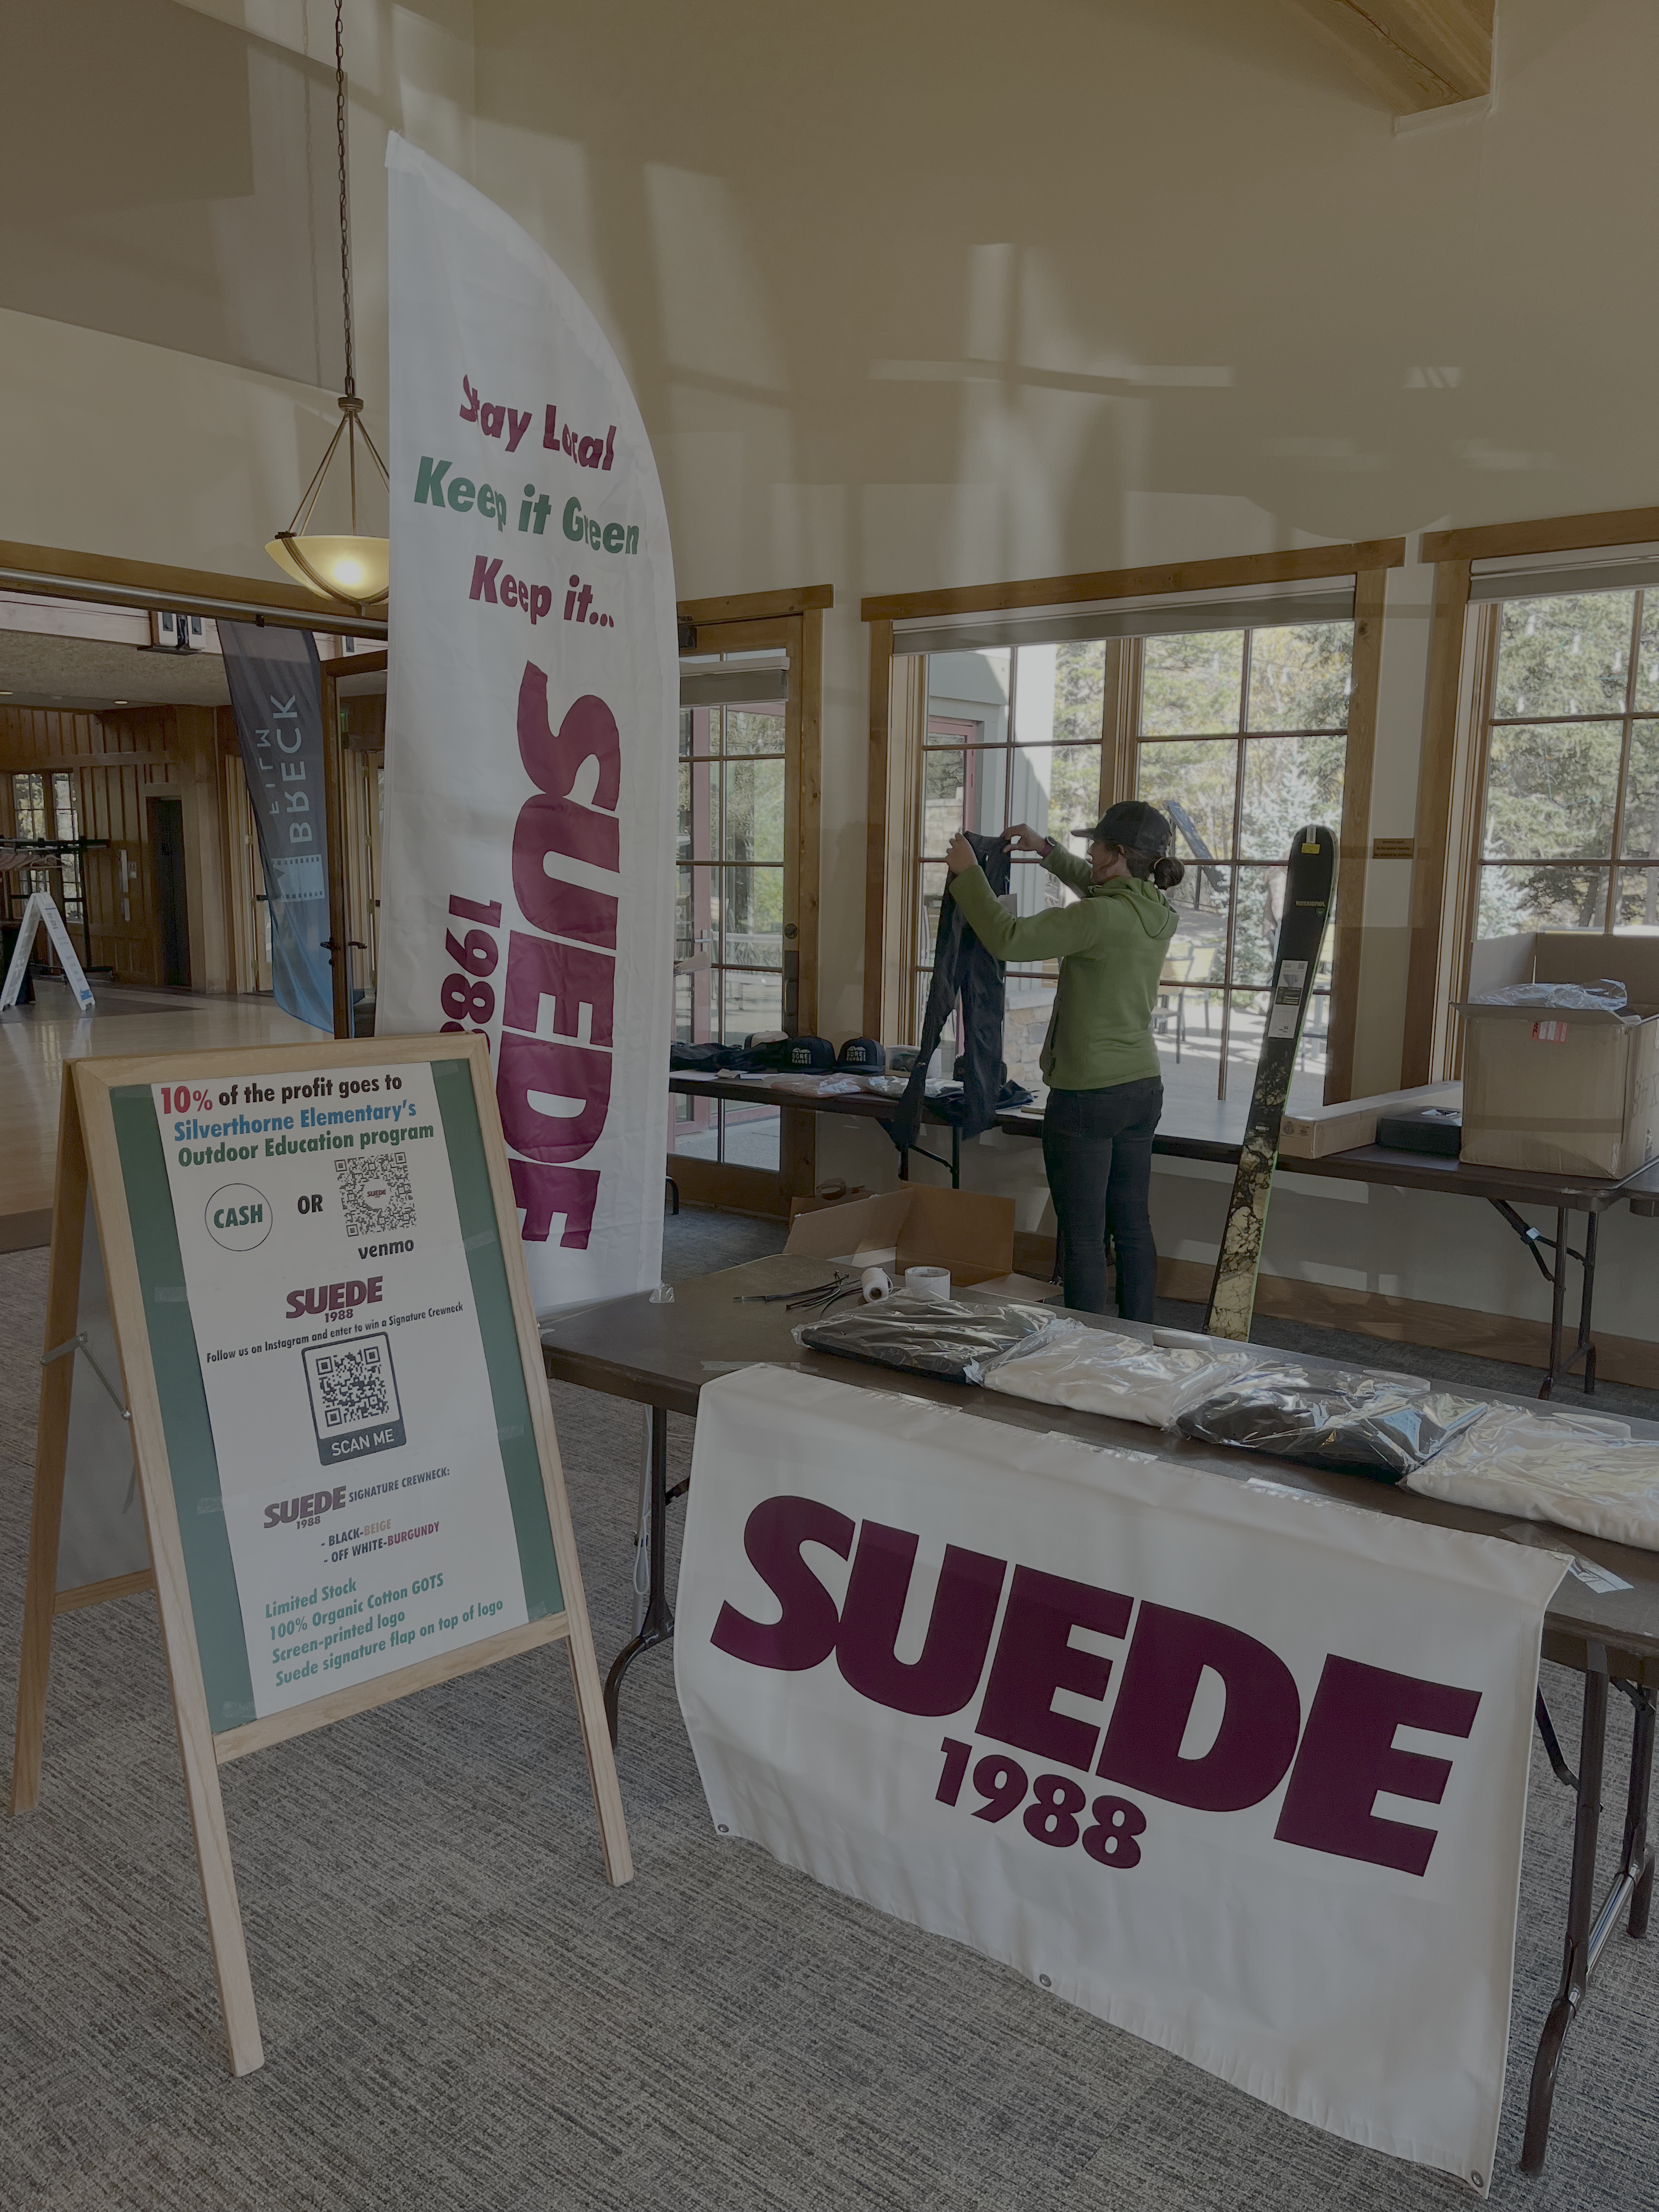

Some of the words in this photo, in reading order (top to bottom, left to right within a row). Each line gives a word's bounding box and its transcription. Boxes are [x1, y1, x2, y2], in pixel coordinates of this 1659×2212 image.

[459, 374, 532, 453] Stay
[543, 404, 616, 471] Local
[414, 456, 506, 532] Keep
[518, 483, 551, 535] it
[562, 496, 639, 555] Green
[469, 555, 552, 625] Keep
[563, 574, 614, 628] it...
[440, 894, 501, 1054] 198
[496, 660, 621, 1250] SUEDE
[161, 1086, 213, 1114] 10%
[218, 1085, 238, 1105] of
[244, 1083, 274, 1103] the
[282, 1077, 333, 1103] profit
[339, 1078, 379, 1097] goes
[385, 1075, 402, 1091] to
[174, 1114, 294, 1142] Silverthorne
[301, 1099, 416, 1128] Elementary's
[178, 1142, 258, 1167] Outdoor
[265, 1131, 354, 1157] Education
[360, 1125, 434, 1149] program
[213, 1204, 263, 1228] CASH
[297, 1194, 323, 1214] OR
[358, 1239, 414, 1260] venmo
[286, 1276, 383, 1319] SUEDE
[325, 1308, 354, 1323] 1988
[207, 1350, 235, 1363] Follow
[239, 1347, 249, 1356] us
[251, 1345, 262, 1353] on
[265, 1335, 309, 1351] Instagram
[312, 1329, 328, 1341] and
[330, 1326, 352, 1338] enter
[354, 1323, 363, 1333] to
[365, 1319, 379, 1331] win
[389, 1311, 426, 1327] Signature
[428, 1302, 463, 1317] Crewneck
[331, 1435, 370, 1457] SCAN
[373, 1428, 394, 1446] ME
[264, 1486, 346, 1528] SUEDE
[349, 1479, 399, 1502] SIGNATURE
[402, 1467, 450, 1488] CREWNECK:
[296, 1516, 321, 1530] 1988
[331, 1548, 349, 1563] OFF
[352, 1521, 440, 1557] WHITE-BURGUNDY
[265, 1589, 318, 1619] Limited
[322, 1577, 357, 1601] Stock
[270, 1614, 308, 1640] 100%
[312, 1599, 363, 1628] Organic
[367, 1587, 408, 1609] Cotton
[412, 1572, 444, 1595] GOTS
[272, 1621, 374, 1664] Screen-printed
[377, 1610, 405, 1631] logo
[276, 1663, 319, 1686] Suede
[323, 1640, 386, 1671] signature
[390, 1630, 416, 1649] flap
[420, 1625, 435, 1638] on
[438, 1617, 459, 1635] top
[462, 1607, 475, 1623] of
[478, 1599, 504, 1619] logo
[710, 1494, 1482, 1877] SUEDE
[934, 1736, 1147, 1869] 1988
